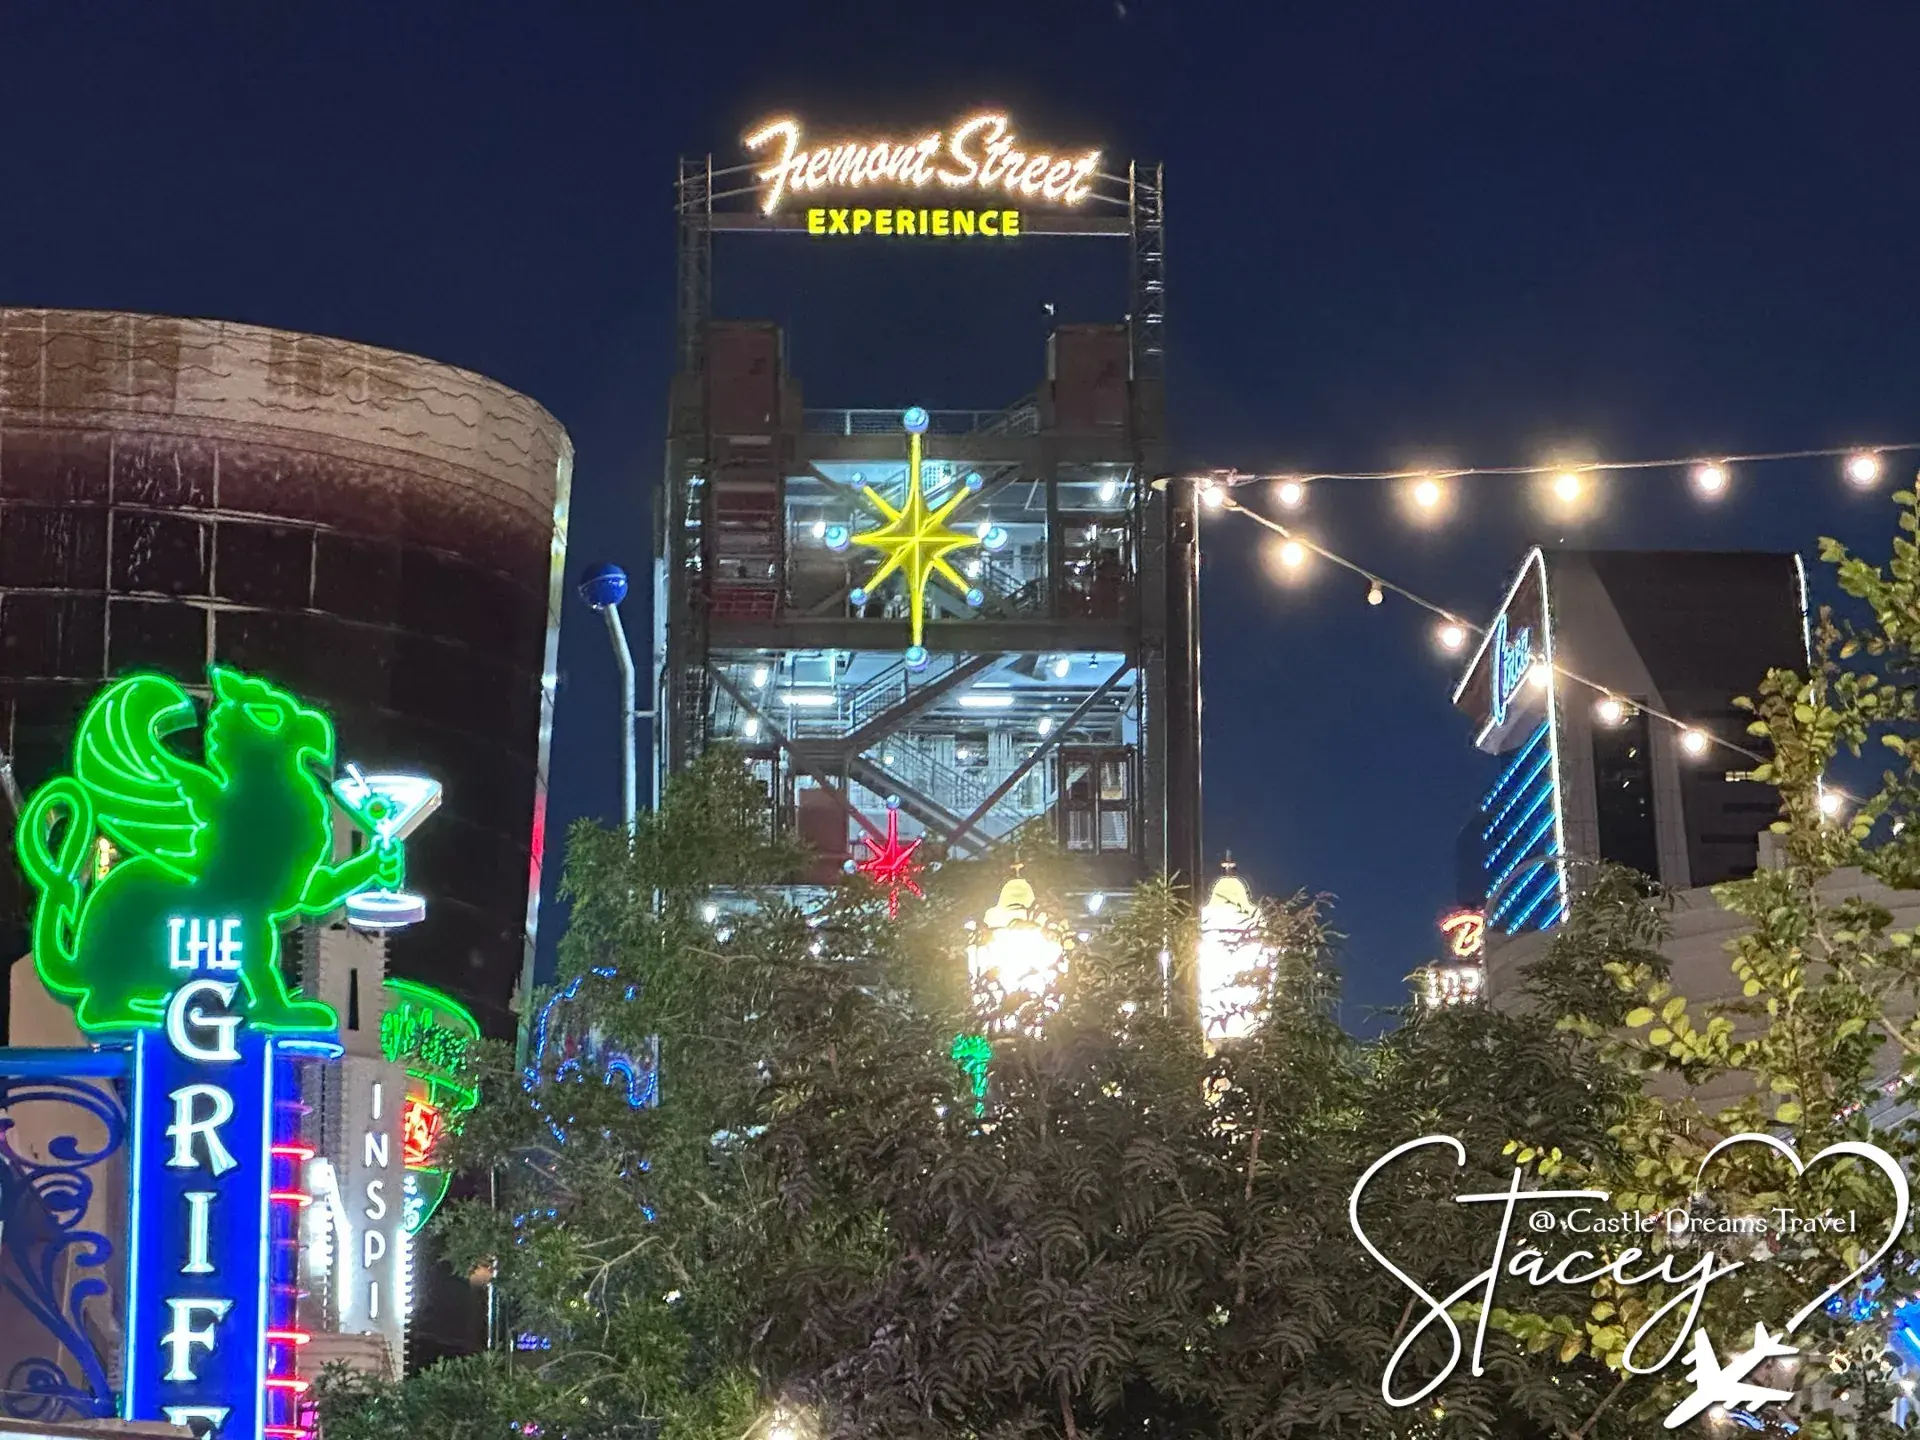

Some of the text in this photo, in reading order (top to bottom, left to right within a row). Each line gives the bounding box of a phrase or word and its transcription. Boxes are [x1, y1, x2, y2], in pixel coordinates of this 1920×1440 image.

[746, 111, 1101, 217] Fremont Street
[808, 208, 1020, 237] EXPERIENCE
[167, 918, 243, 970] THE
[363, 1082, 390, 1321] INSPI
